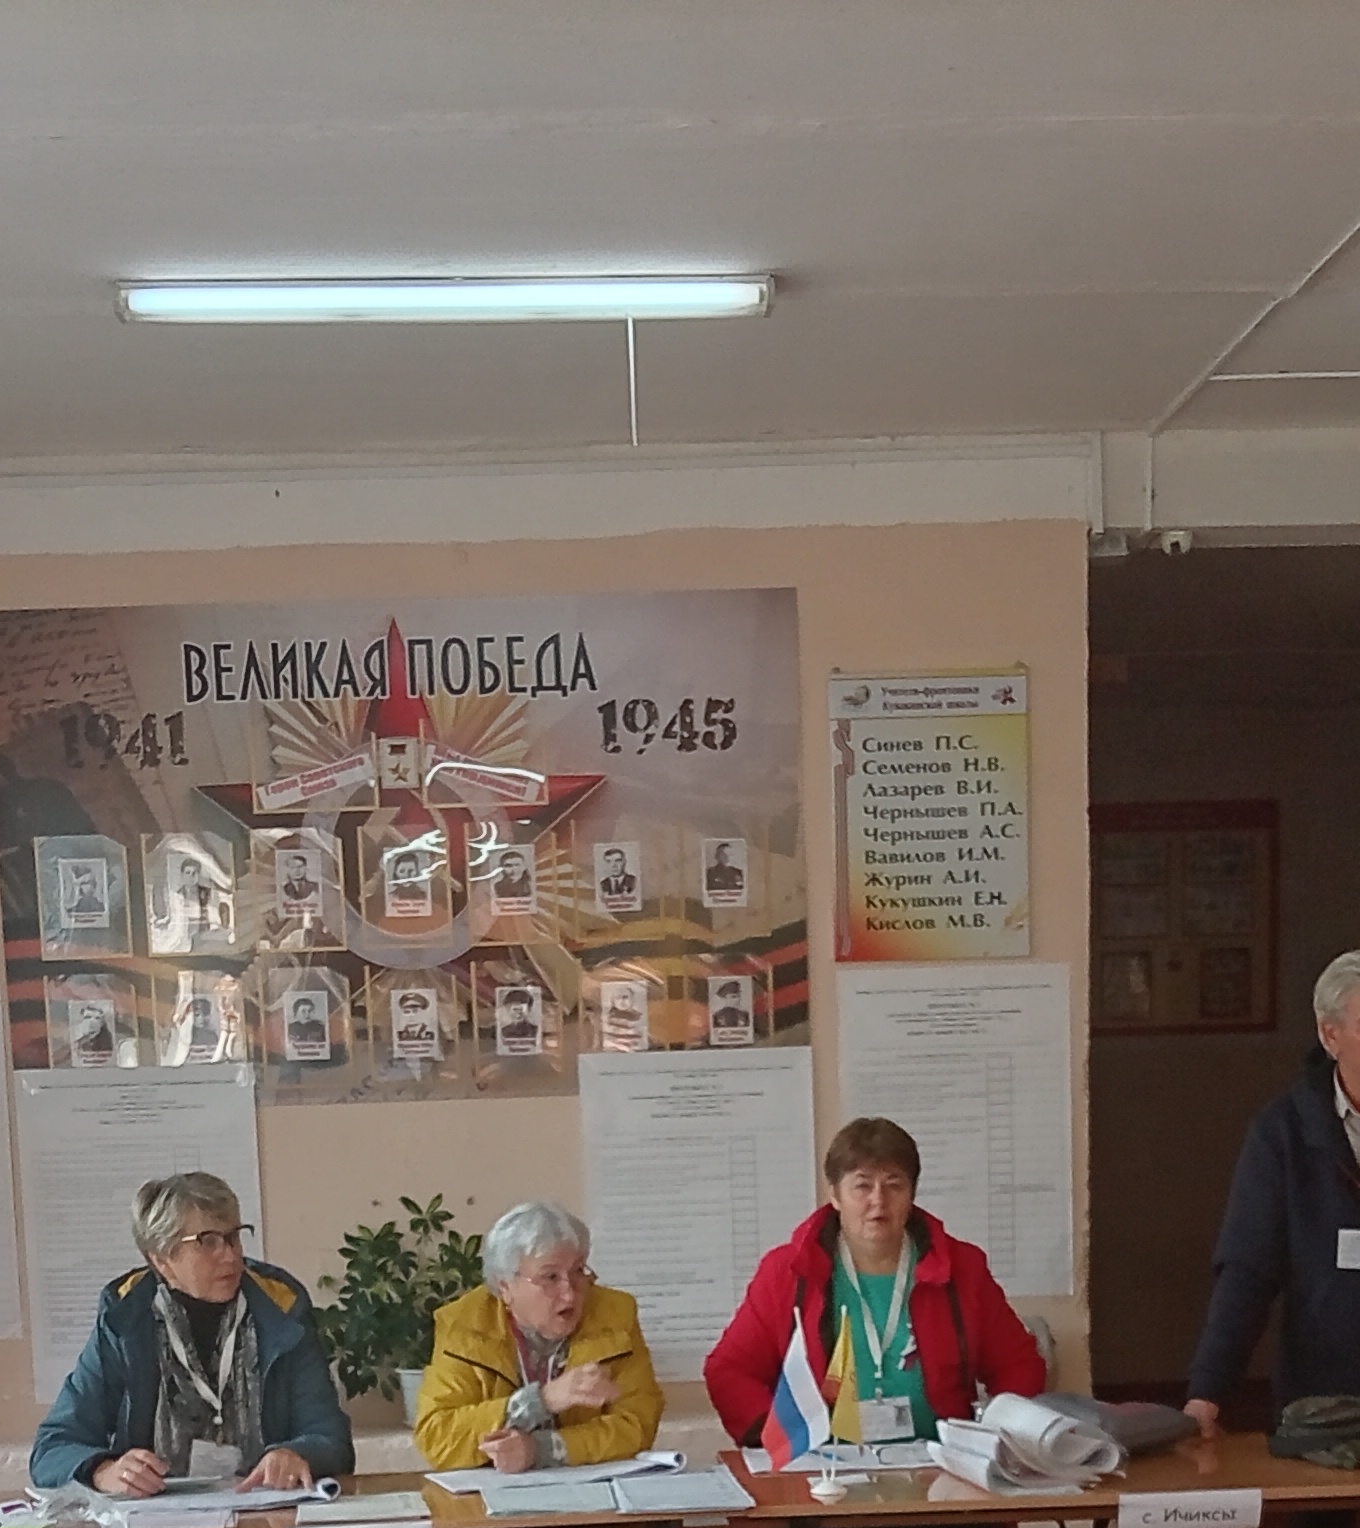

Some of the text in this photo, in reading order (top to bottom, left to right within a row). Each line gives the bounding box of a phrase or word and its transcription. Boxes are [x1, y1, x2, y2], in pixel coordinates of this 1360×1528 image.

[183, 638, 388, 702] ВЕЛИКАЯ
[407, 632, 598, 698] ПОБЕДА
[597, 697, 737, 755] 1945
[60, 711, 189, 770] 1941
[862, 735, 978, 753] Синев П.С.
[862, 757, 1005, 776] Семенов Н.В.
[863, 780, 999, 801] Лазарев В.И.
[863, 801, 1023, 823] Чернышев П.А.
[863, 823, 1020, 846] Чернышев А.С.
[864, 847, 1006, 864] Вавилов И.М.
[864, 870, 987, 890] Журин А.И.
[865, 895, 963, 911] Кукушкин
[866, 913, 991, 931] Кислов М.В.
[1164, 1508, 1237, 1522] Ичиксы
